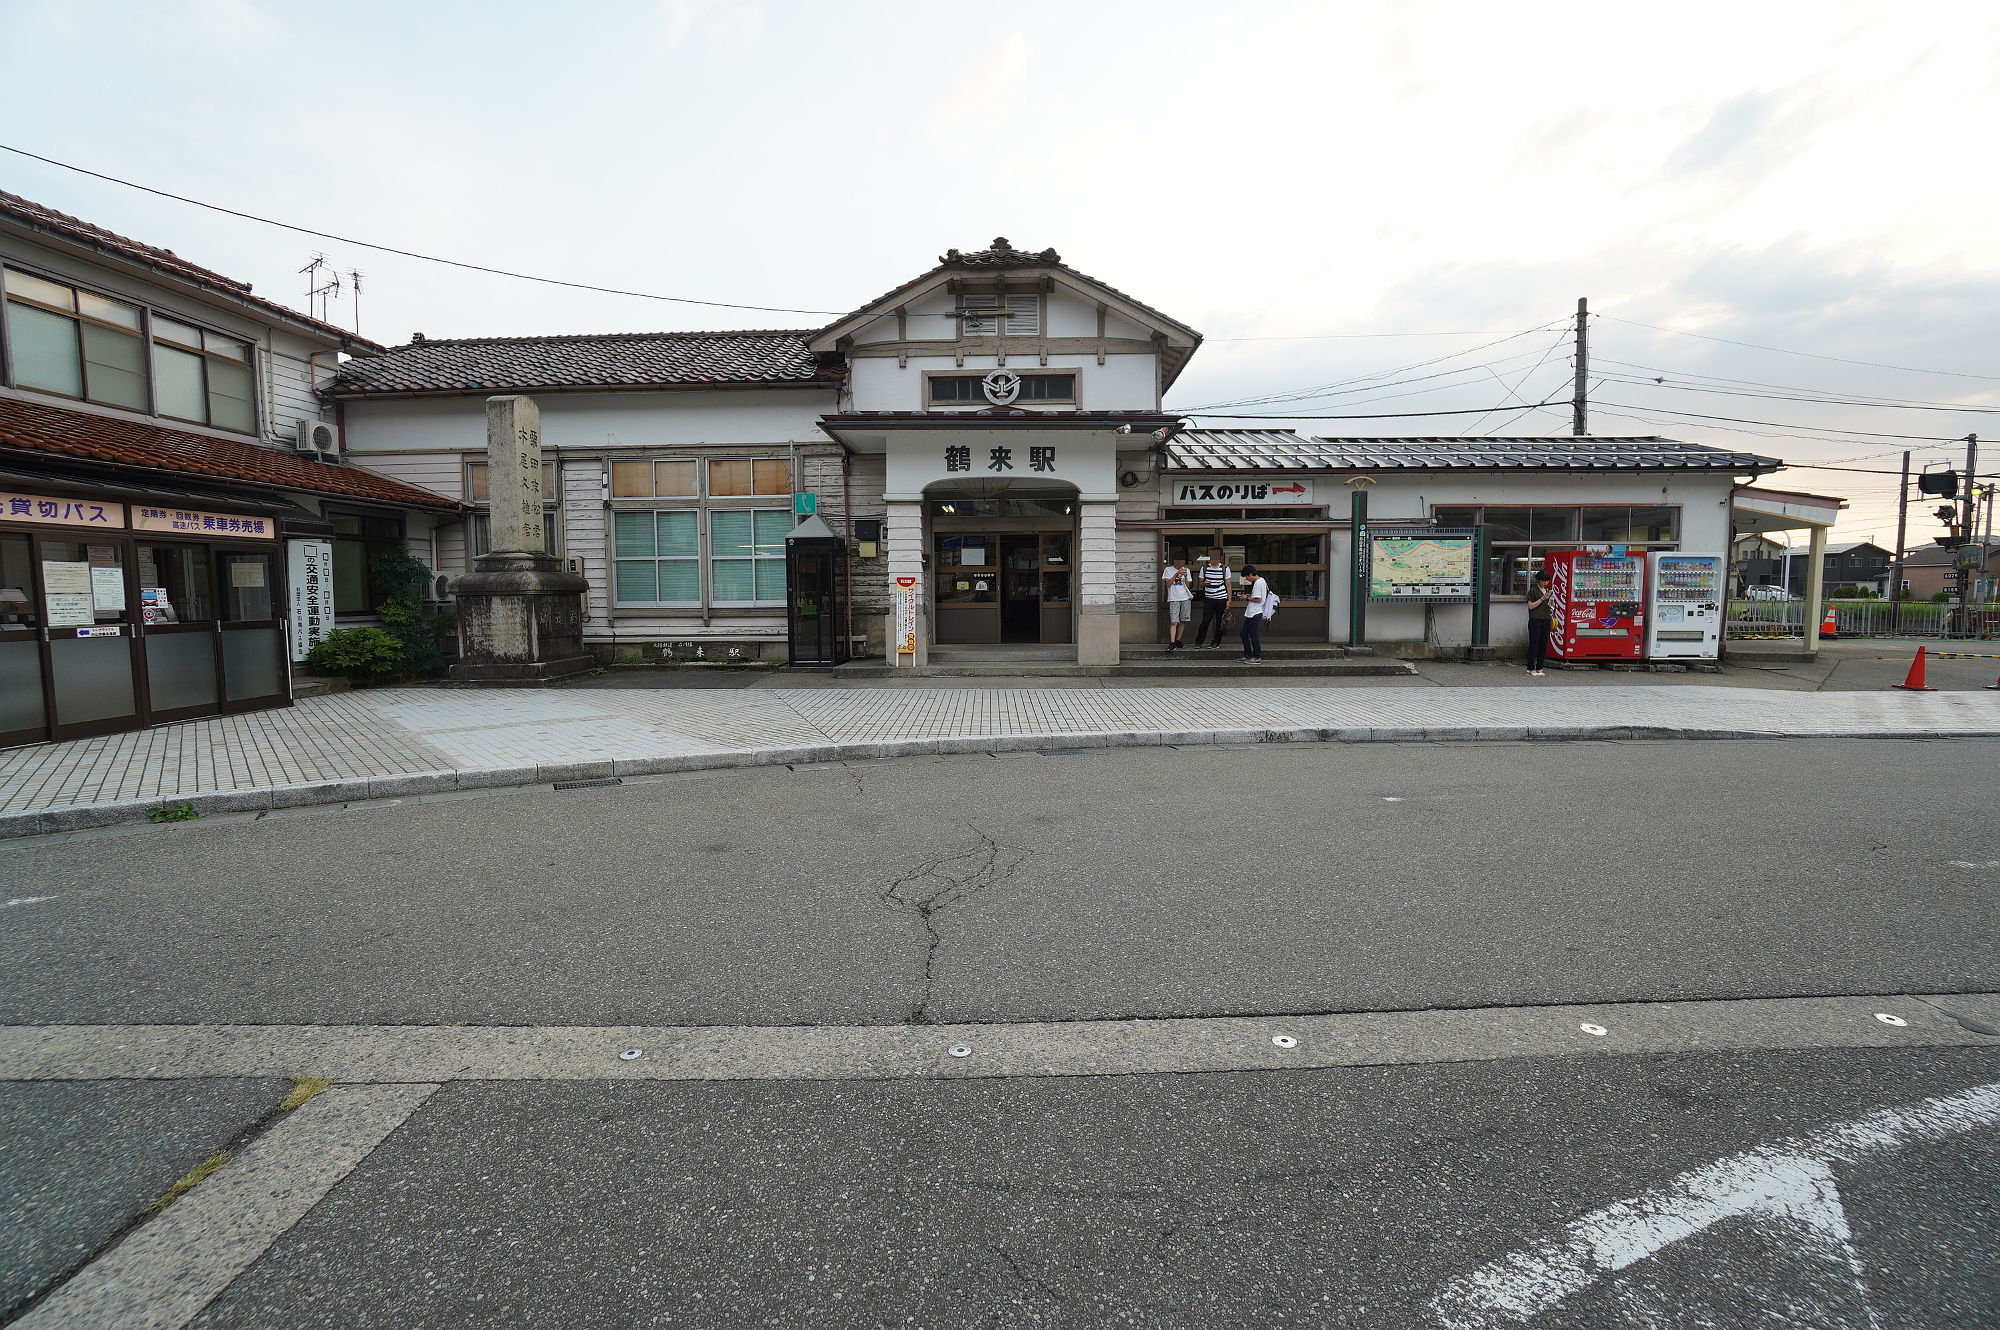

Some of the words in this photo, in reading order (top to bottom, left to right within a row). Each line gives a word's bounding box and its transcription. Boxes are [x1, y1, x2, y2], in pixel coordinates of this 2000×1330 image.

[944, 445, 1056, 472] 鶴来駅
[1180, 483, 1270, 500] バスのりば
[0, 498, 108, 522] 貸切バス
[172, 520, 201, 530] 高速バス
[203, 516, 265, 534] 乗車券売場
[662, 646, 741, 658] 鶴来駅
